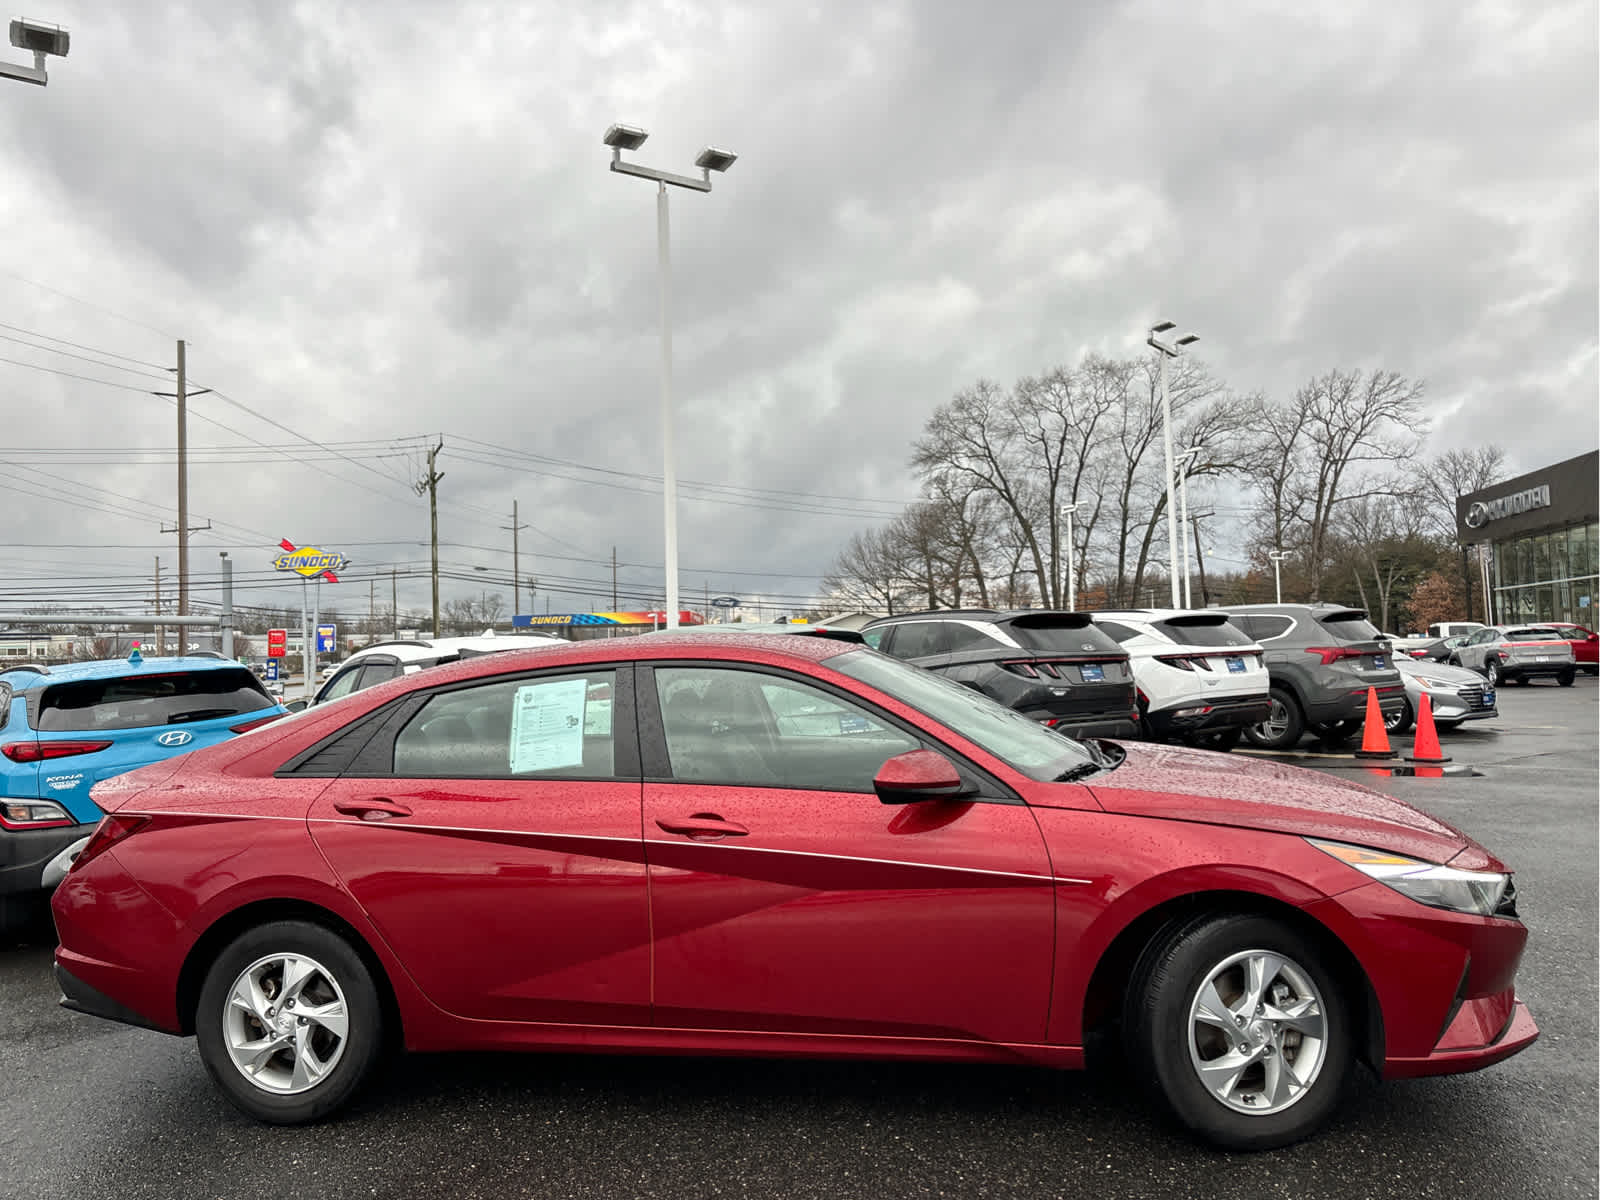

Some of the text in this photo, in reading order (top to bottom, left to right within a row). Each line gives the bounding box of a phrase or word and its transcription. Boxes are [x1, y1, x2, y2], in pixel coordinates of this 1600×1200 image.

[278, 555, 339, 569] SUNOCO
[530, 615, 573, 625] SUNOCO
[46, 773, 84, 783] KONA
